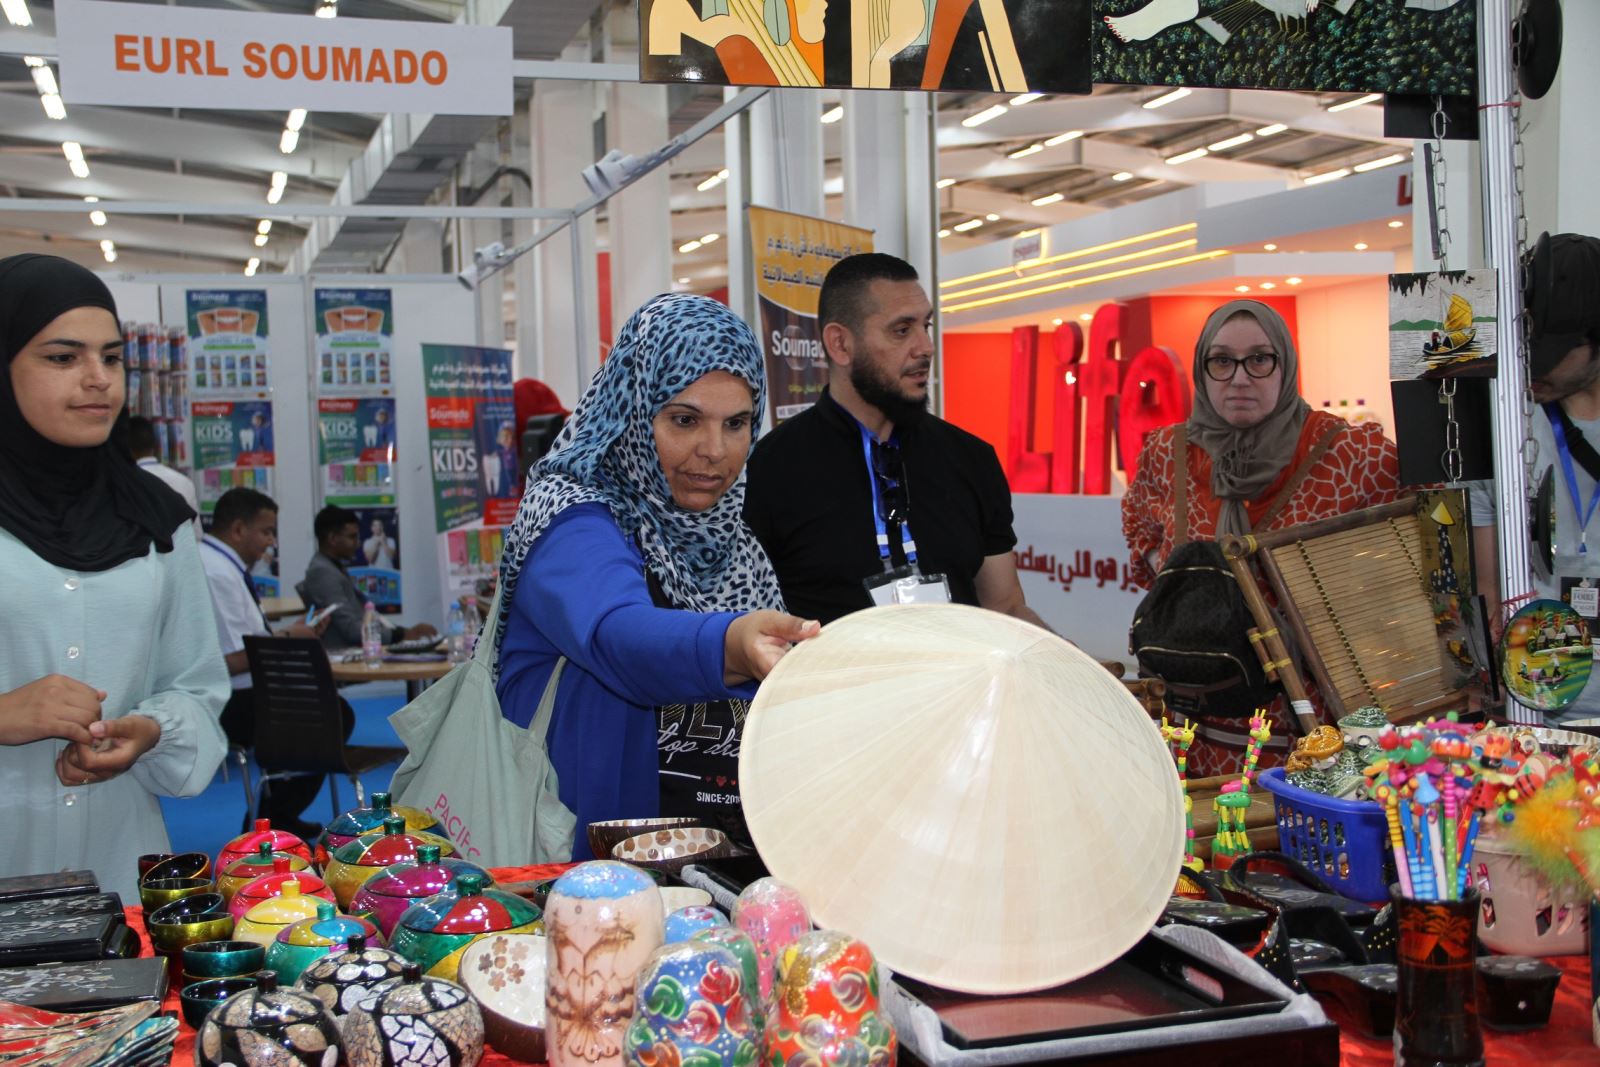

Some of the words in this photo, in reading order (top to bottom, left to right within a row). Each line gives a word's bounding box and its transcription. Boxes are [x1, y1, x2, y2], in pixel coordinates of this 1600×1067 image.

[114, 34, 229, 76] EURL
[243, 42, 448, 86] SOUMADO
[771, 330, 826, 358] Souma
[1010, 302, 1192, 496] Life
[195, 424, 233, 442] KIDS
[323, 420, 358, 438] KIDS
[433, 448, 478, 472] KIDS
[1095, 557, 1118, 588] هو
